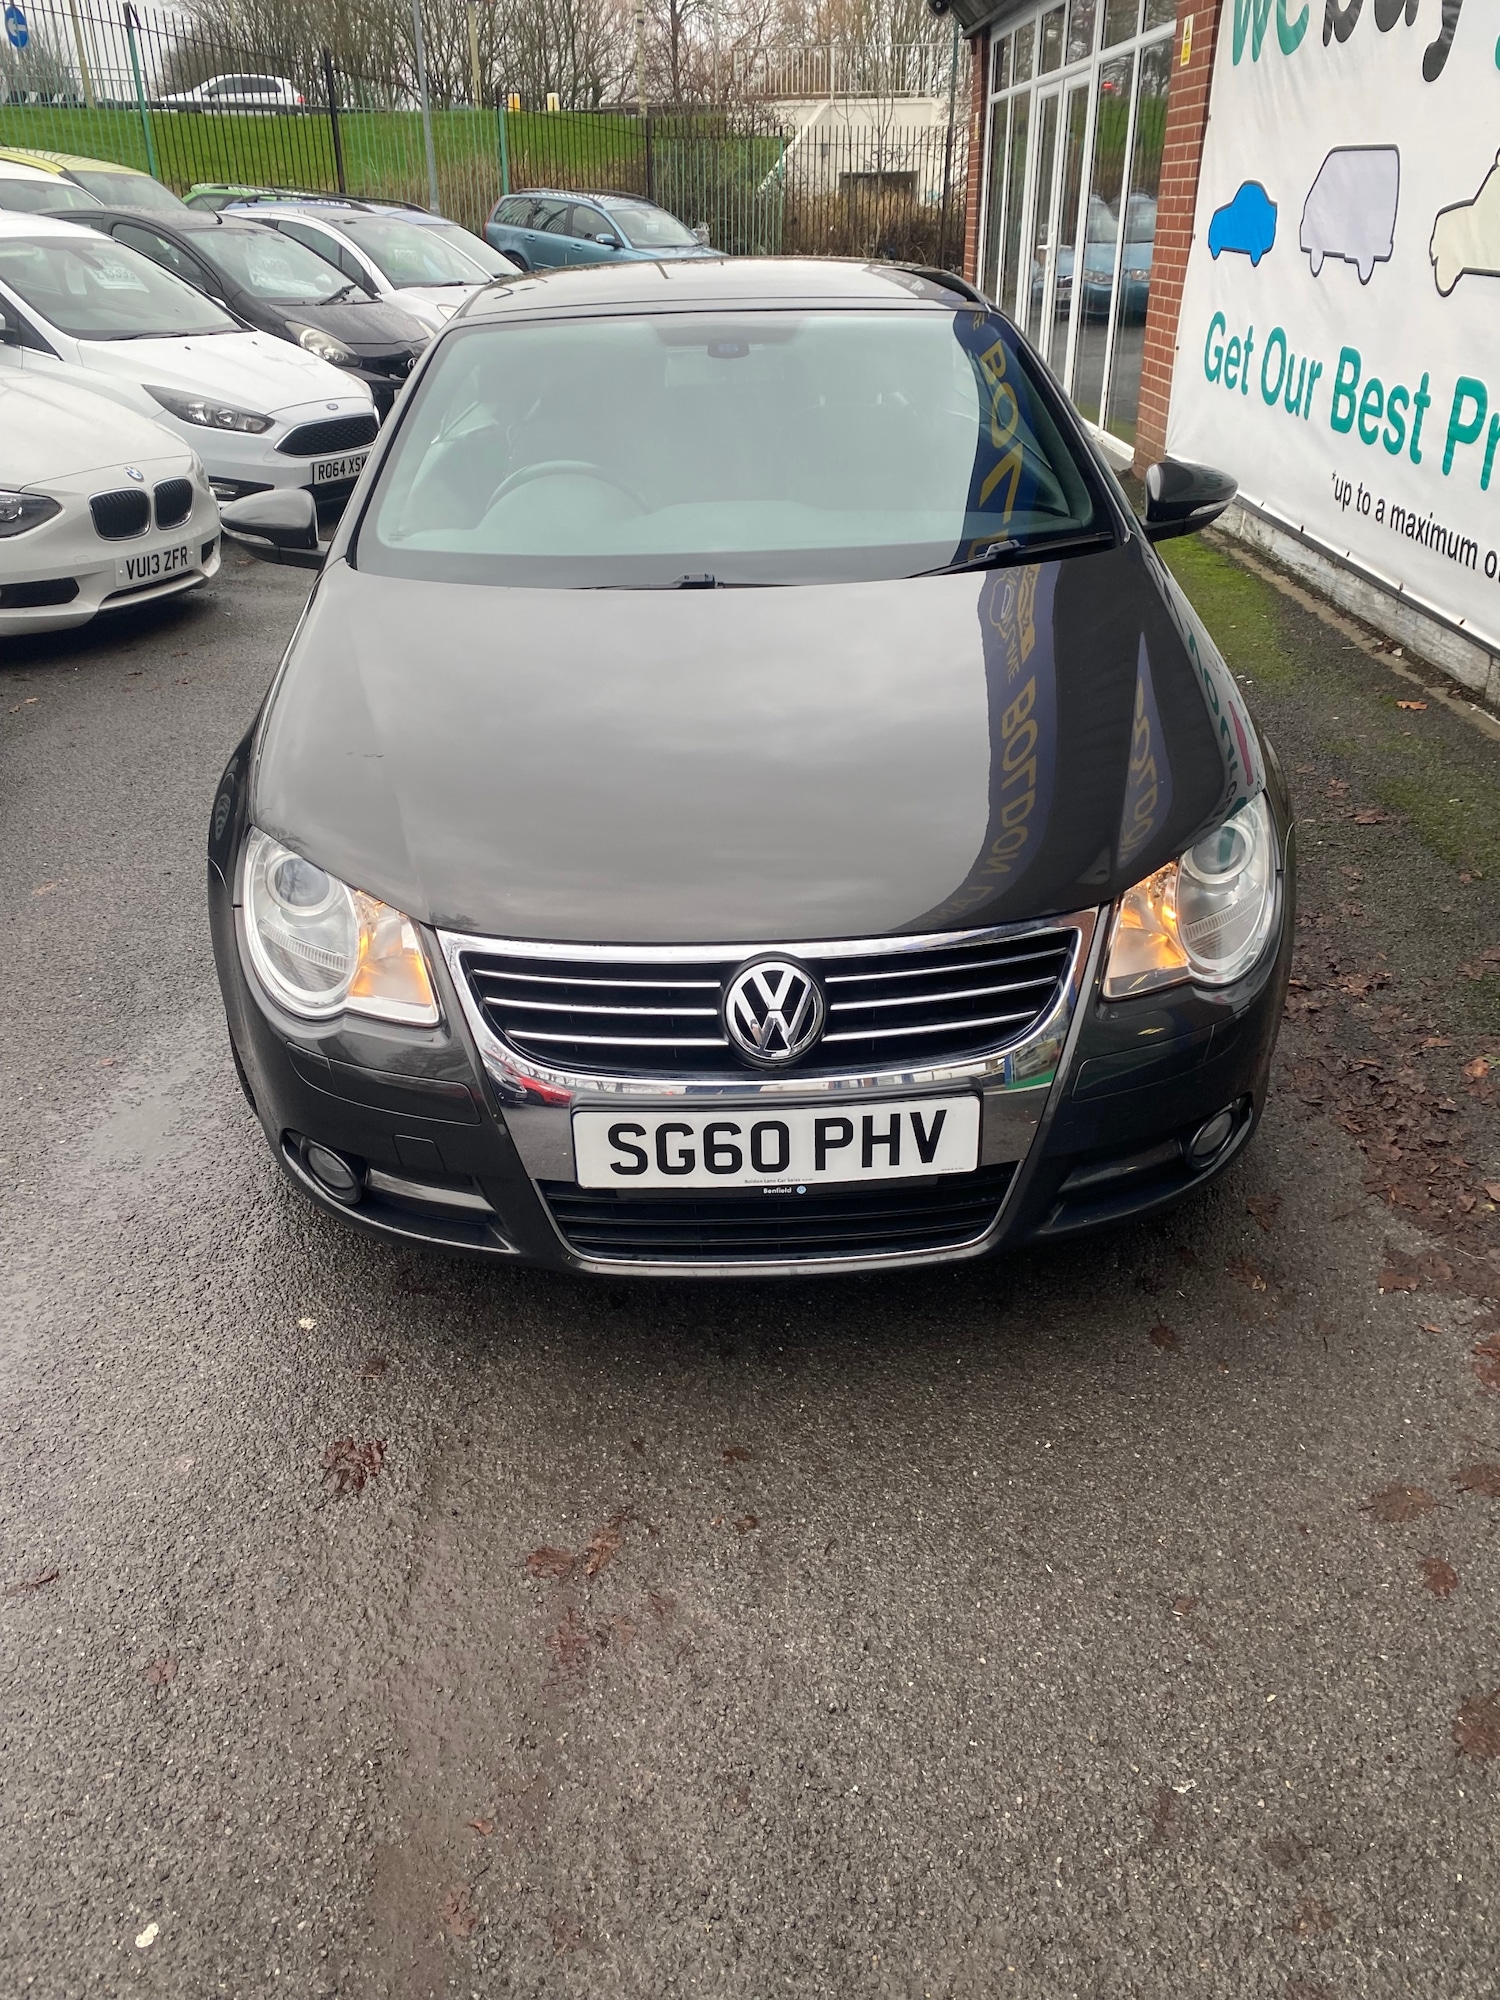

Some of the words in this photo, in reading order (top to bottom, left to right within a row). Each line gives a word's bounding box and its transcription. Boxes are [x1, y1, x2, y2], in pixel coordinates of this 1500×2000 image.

[1204, 311, 1254, 396] Get
[1261, 326, 1323, 421] Our
[1330, 346, 1432, 465] Best
[126, 553, 160, 580] VU13
[163, 545, 188, 572] ZFR
[1356, 482, 1371, 516] to
[1375, 499, 1385, 524] a
[1390, 504, 1479, 570] maximum
[607, 1121, 790, 1176] SG60
[814, 1109, 947, 1171] PHV
